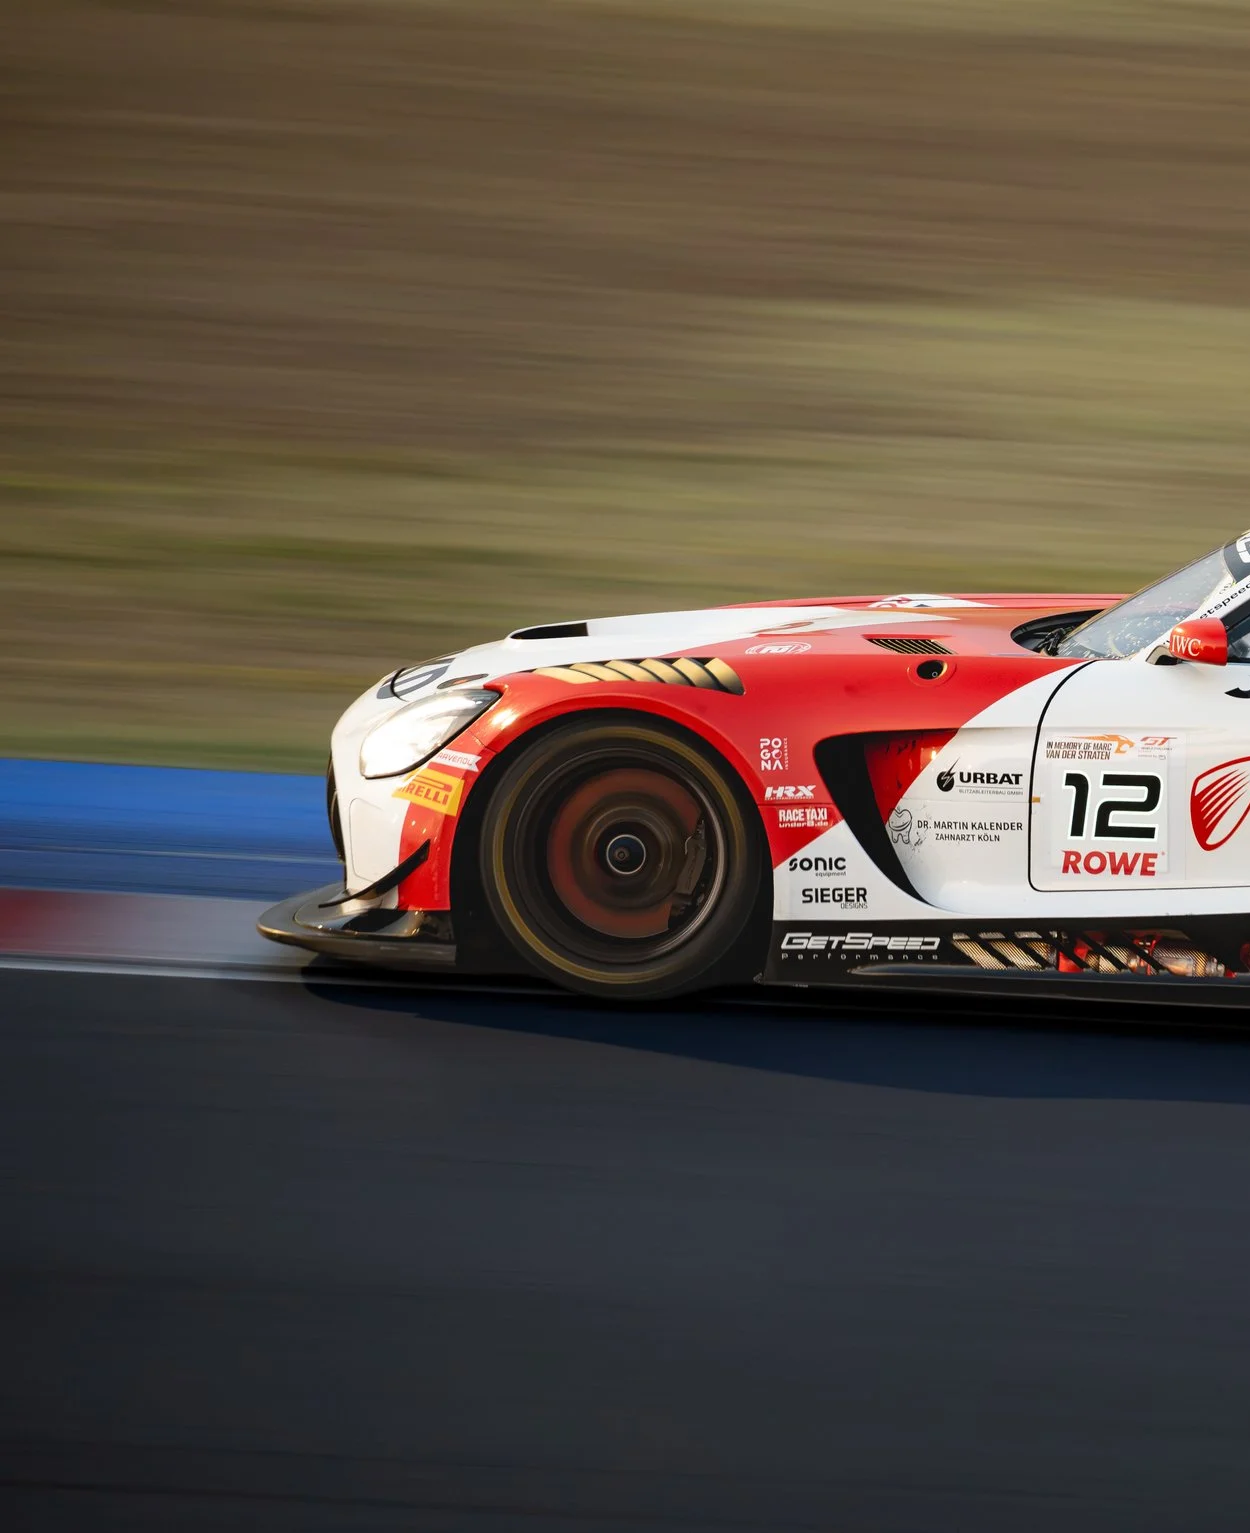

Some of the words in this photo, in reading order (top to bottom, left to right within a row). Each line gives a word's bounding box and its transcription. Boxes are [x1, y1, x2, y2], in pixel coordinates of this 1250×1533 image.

[1171, 634, 1201, 656] IWC
[1046, 741, 1053, 749] IN
[1054, 741, 1081, 750] MEMORY
[1083, 742, 1091, 750] OF
[1093, 742, 1113, 751] MARC
[1046, 749, 1060, 759] VAN
[1061, 750, 1076, 760] DER
[1079, 751, 1111, 760] STRATEN
[960, 772, 1023, 785] URBAT
[764, 785, 816, 798] HRX
[1065, 773, 1162, 839] 12
[779, 808, 805, 822] RACE
[805, 807, 828, 820] TAXI
[917, 820, 932, 829] DR.
[934, 820, 969, 830] MARTIN
[971, 821, 1023, 831] KALENDER
[935, 833, 976, 842] ZAHNARZT
[978, 833, 1001, 842] KÖLN
[1062, 850, 1158, 876] ROWE
[802, 887, 868, 904] SIEGER
[840, 902, 868, 910] DESIGNS
[781, 952, 939, 961] performance
